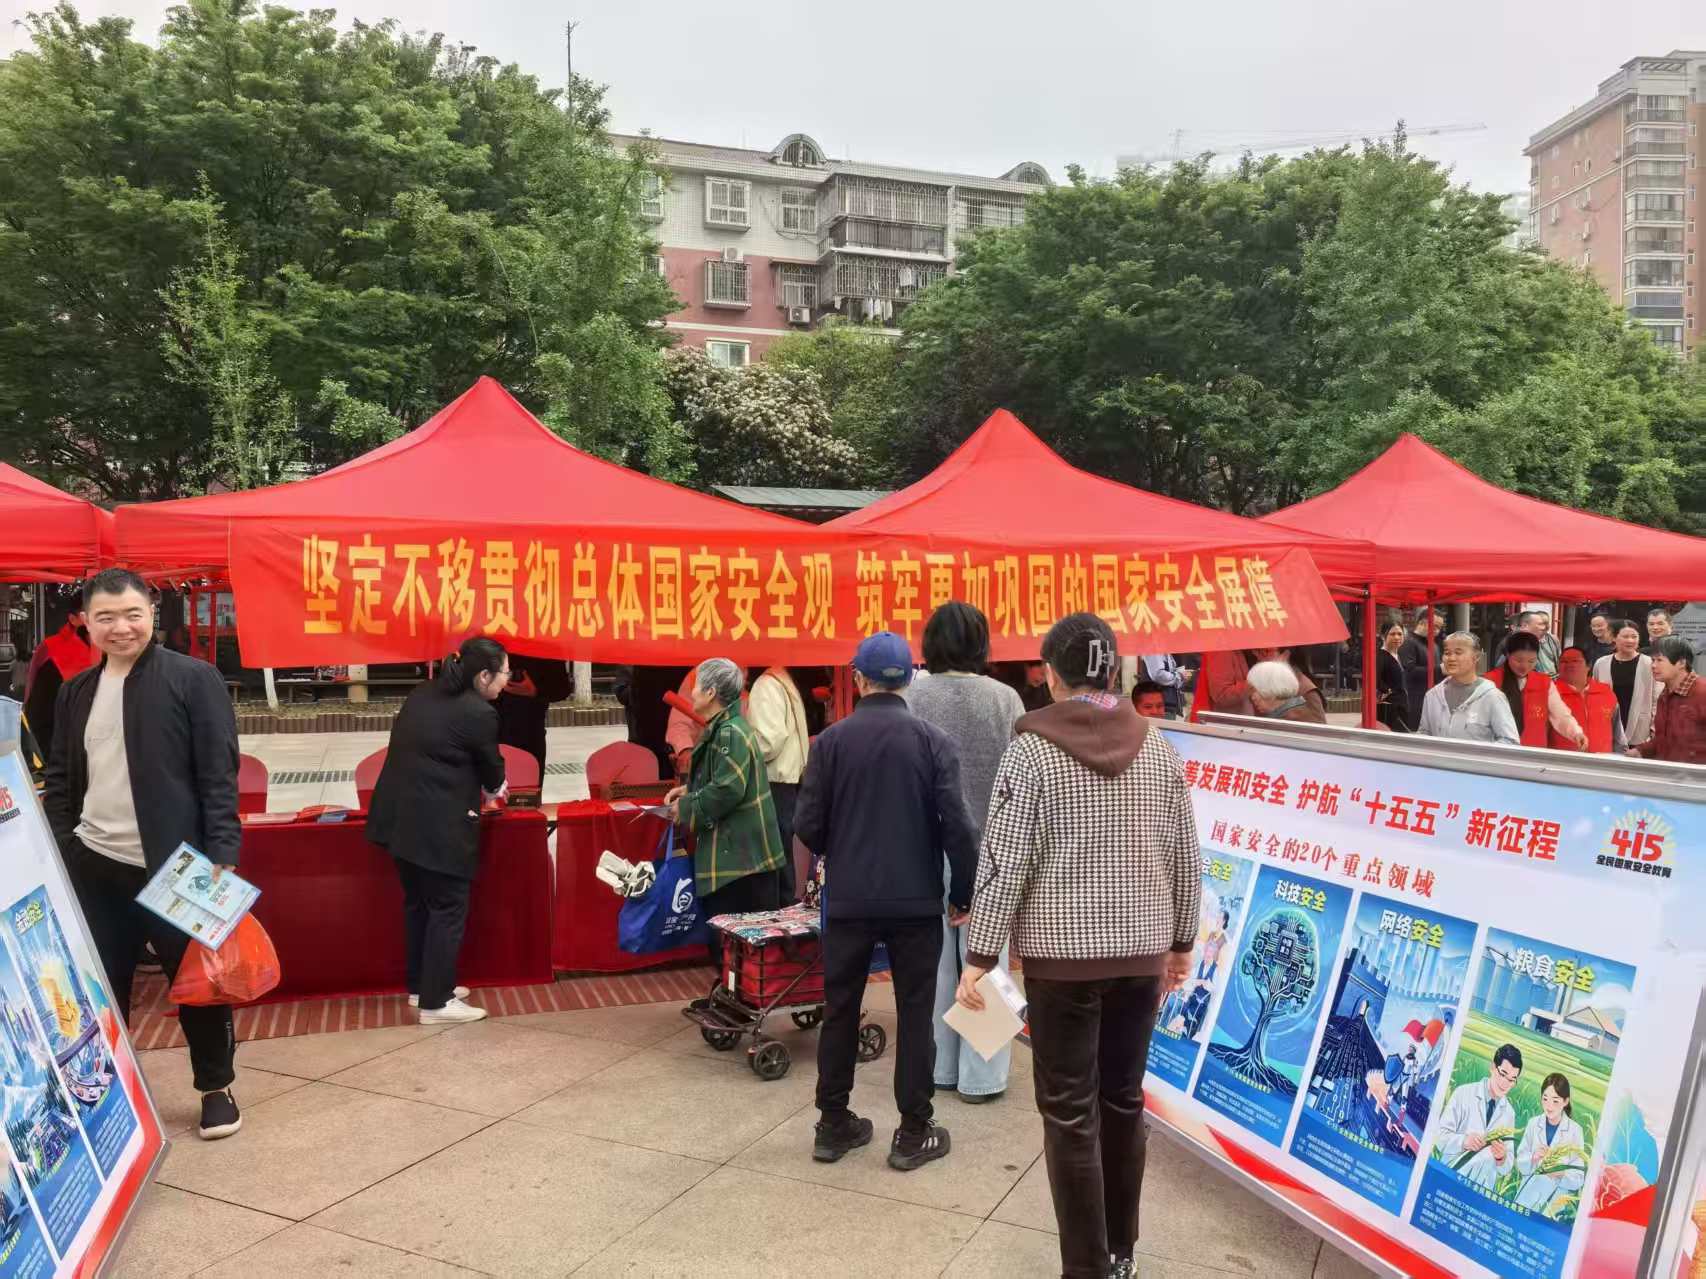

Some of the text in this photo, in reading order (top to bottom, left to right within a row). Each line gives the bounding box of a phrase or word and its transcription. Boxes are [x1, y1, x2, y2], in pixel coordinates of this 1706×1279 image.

[303, 533, 1288, 640] 坚定不移贯彻总体国家安全观 筑牢更加巩固的国家安全屏障
[1211, 819, 1435, 898] 国家安全的20个重点领域
[1611, 829, 1664, 861] 415
[1274, 880, 1327, 912] 科技安全
[1380, 909, 1445, 948] 网络安全
[1511, 947, 1596, 993] 粮食安全
